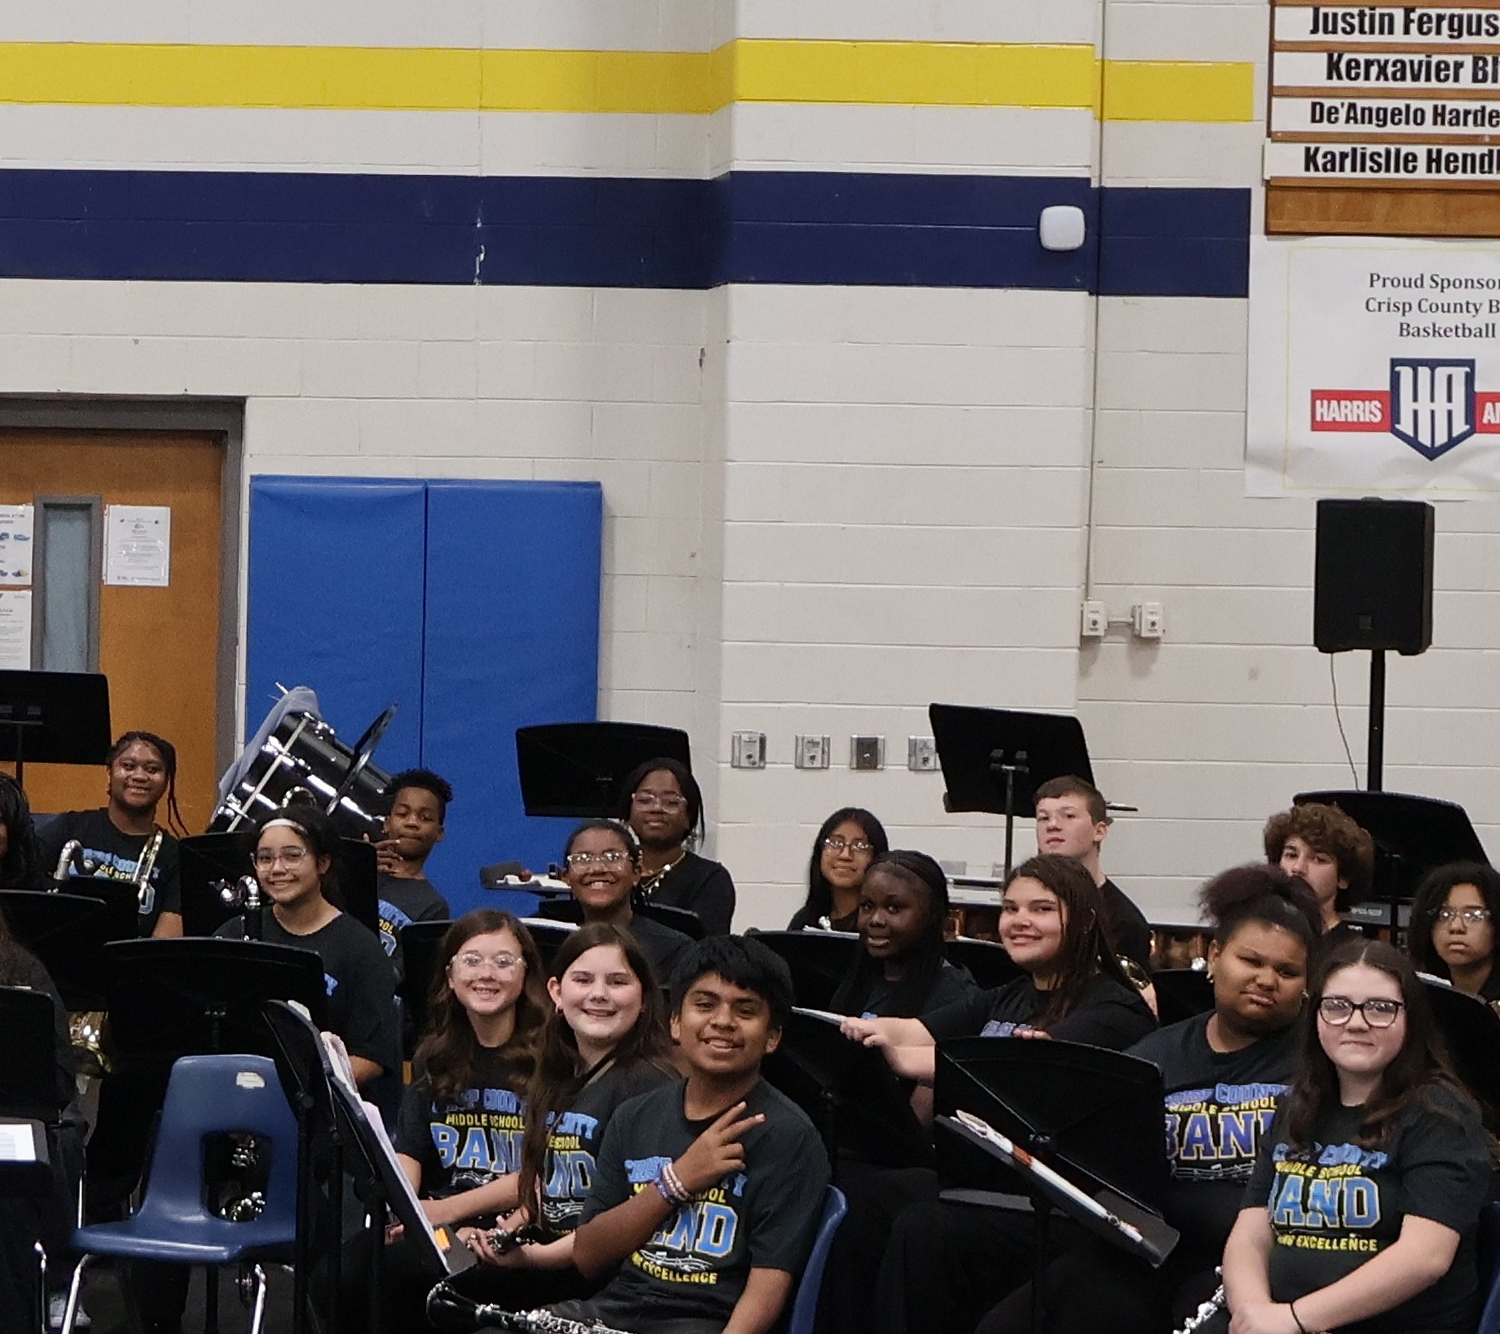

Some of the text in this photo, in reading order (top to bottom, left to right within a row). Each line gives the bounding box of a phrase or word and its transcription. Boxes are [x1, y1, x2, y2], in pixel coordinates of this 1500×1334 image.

[1310, 7, 1395, 36] Justin
[1326, 53, 1464, 83] Kerxavier
[1370, 273, 1424, 288] Proud
[1365, 297, 1412, 317] Crisp
[1418, 298, 1483, 317] County
[1399, 322, 1495, 338] Basketball
[1315, 399, 1382, 423] HARRIS
[1296, 1236, 1377, 1251] EXCELLENCE
